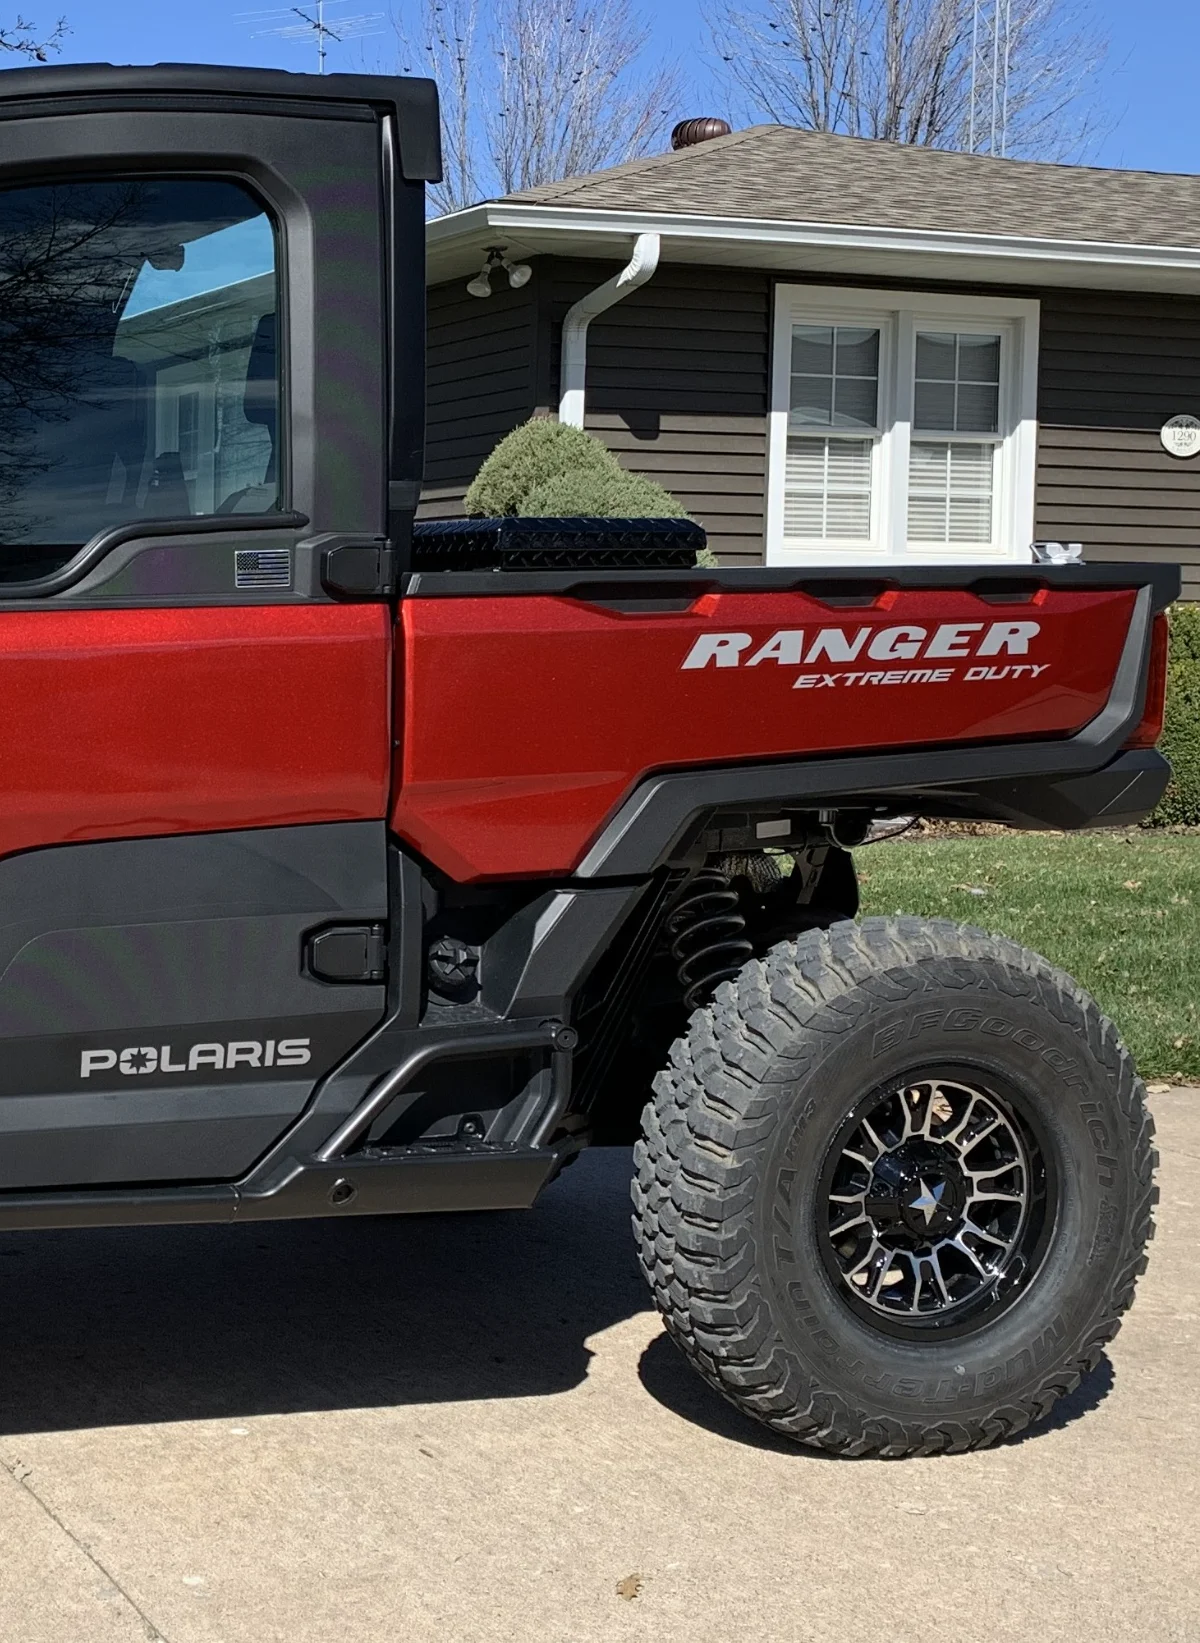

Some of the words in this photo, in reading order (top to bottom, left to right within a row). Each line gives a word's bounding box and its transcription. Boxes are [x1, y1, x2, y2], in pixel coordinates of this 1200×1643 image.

[1172, 430, 1196, 441] 1290
[681, 621, 1041, 670] RANGER
[792, 668, 955, 689] EXTREME
[964, 664, 1050, 681] DUTY
[80, 1038, 312, 1078] POLARIS
[873, 1007, 1118, 1188] BFGoodrich
[773, 1167, 798, 1271] T/A
[787, 1281, 1069, 1404] Mud-Terrain
